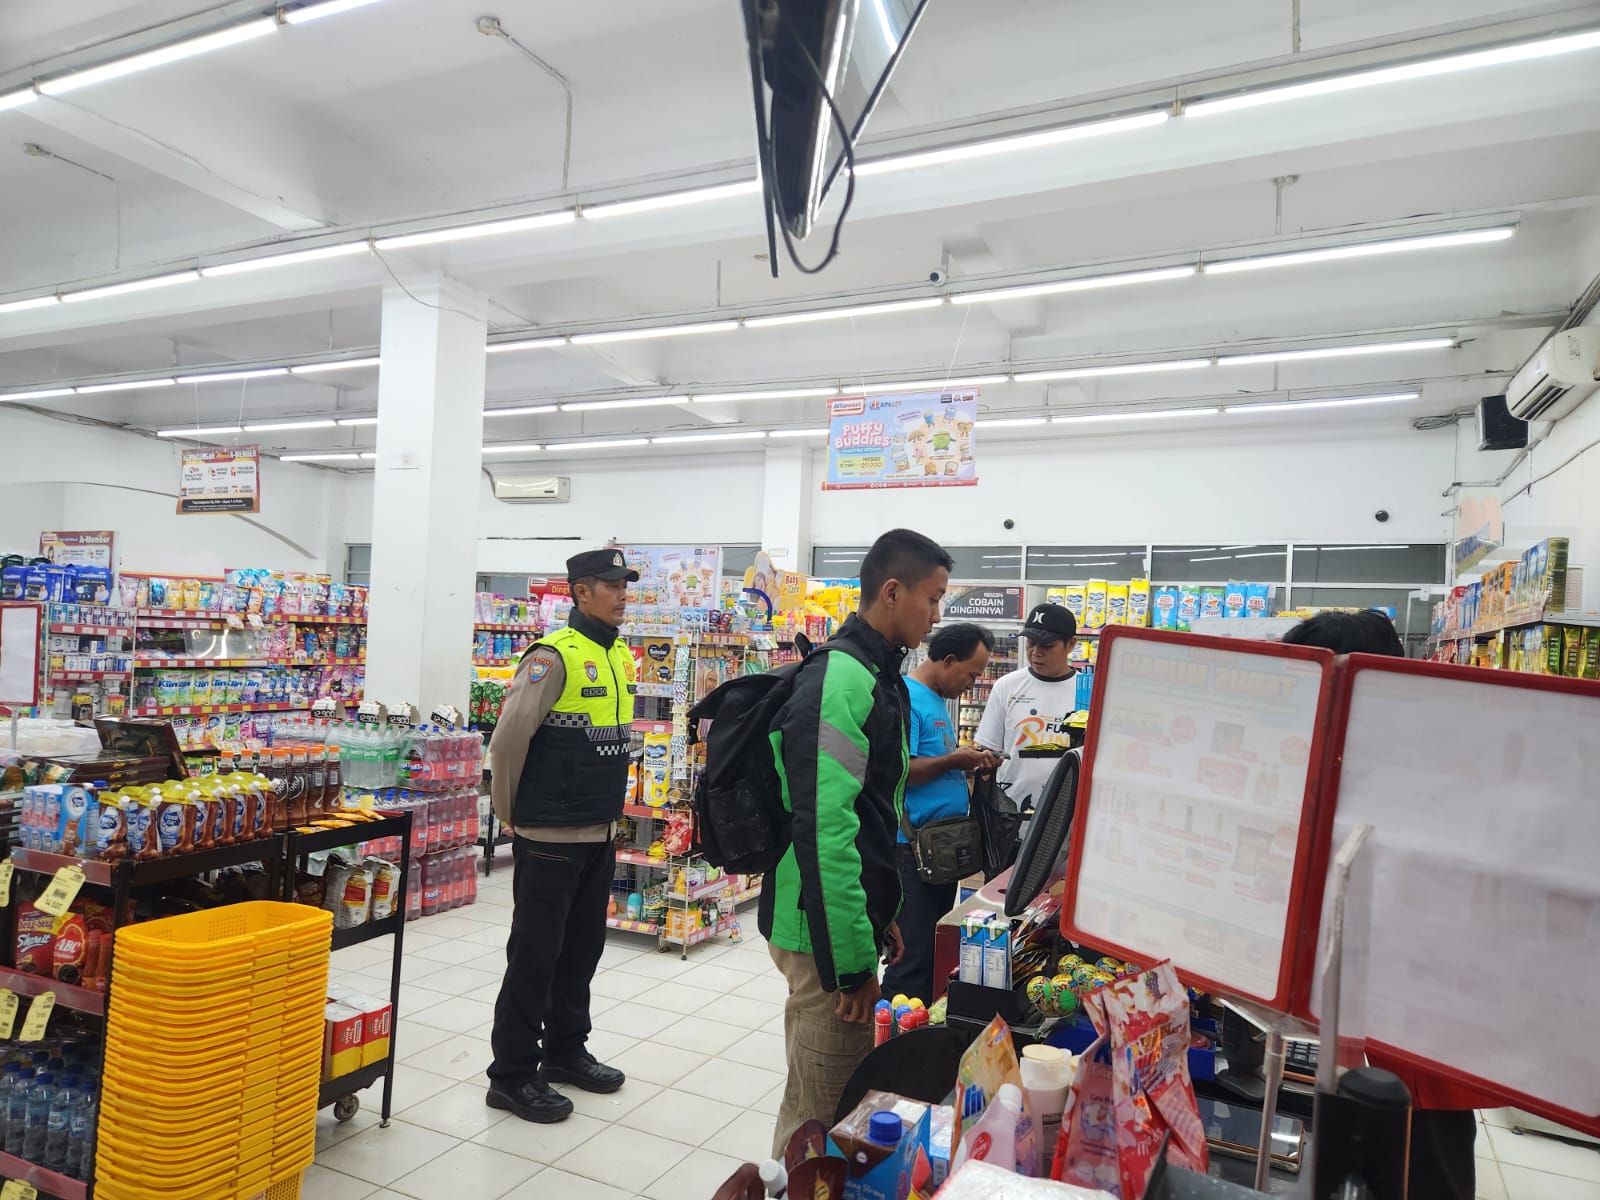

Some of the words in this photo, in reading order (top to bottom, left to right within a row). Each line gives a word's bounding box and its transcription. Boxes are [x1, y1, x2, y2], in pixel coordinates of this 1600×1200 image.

[969, 598, 1004, 606] COBAIN
[950, 606, 1004, 615] DINGINNYA!
[159, 680, 178, 688] Klin
[313, 710, 336, 718] 12.900
[55, 938, 81, 953] ABC
